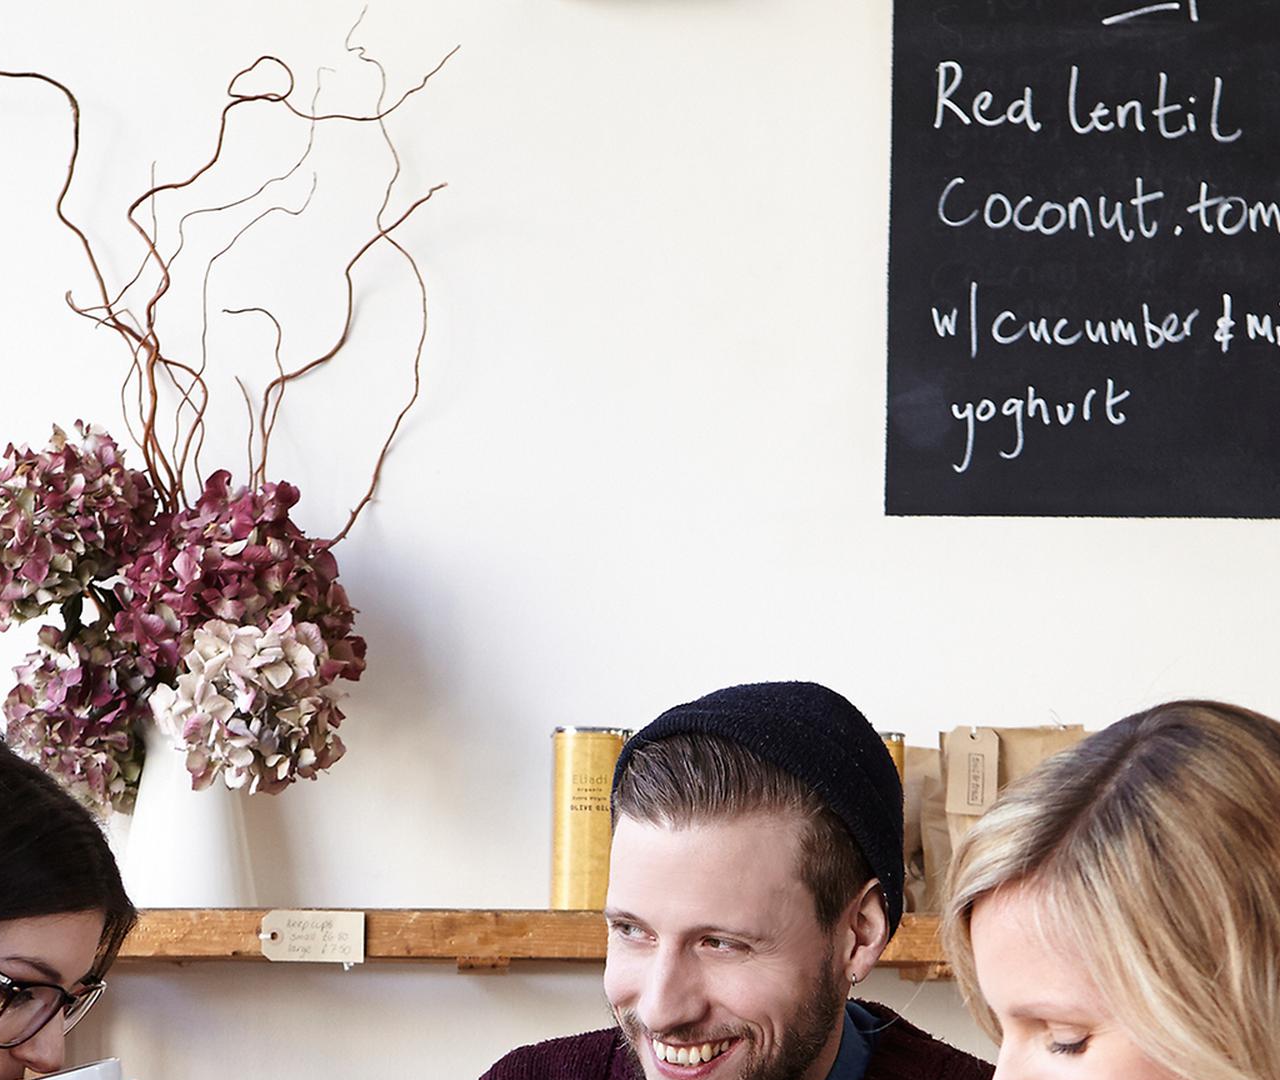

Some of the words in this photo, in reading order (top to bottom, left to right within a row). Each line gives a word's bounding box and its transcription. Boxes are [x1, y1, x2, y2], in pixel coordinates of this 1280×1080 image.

[933, 60, 1042, 133] Red
[1068, 65, 1243, 142] lentil
[951, 378, 1131, 473] yoghurt
